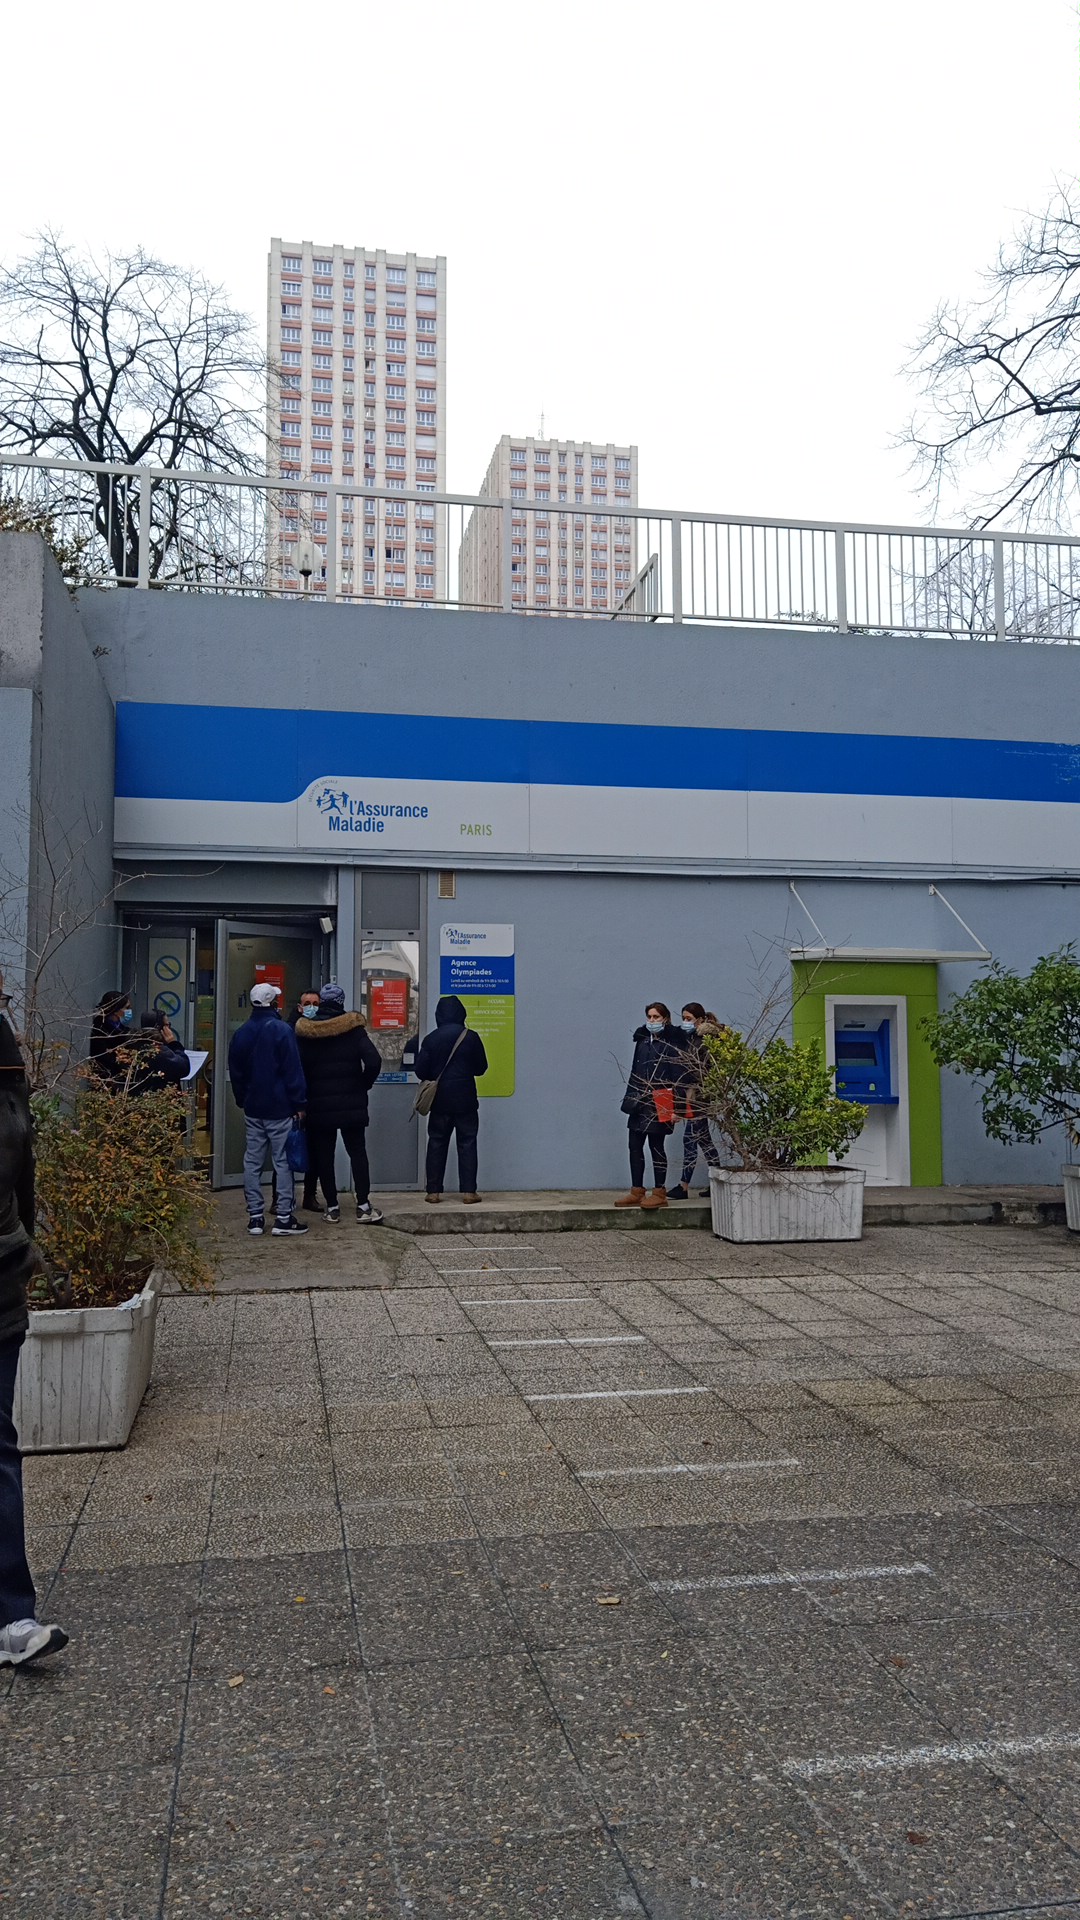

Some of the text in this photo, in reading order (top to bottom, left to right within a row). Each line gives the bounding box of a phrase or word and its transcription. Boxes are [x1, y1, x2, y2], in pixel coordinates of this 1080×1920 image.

[350, 800, 428, 818] l'Assurance
[328, 816, 385, 832] Maladie
[460, 824, 493, 836] PARIS
[450, 959, 477, 967] Agence
[450, 968, 492, 976] Olympiades
